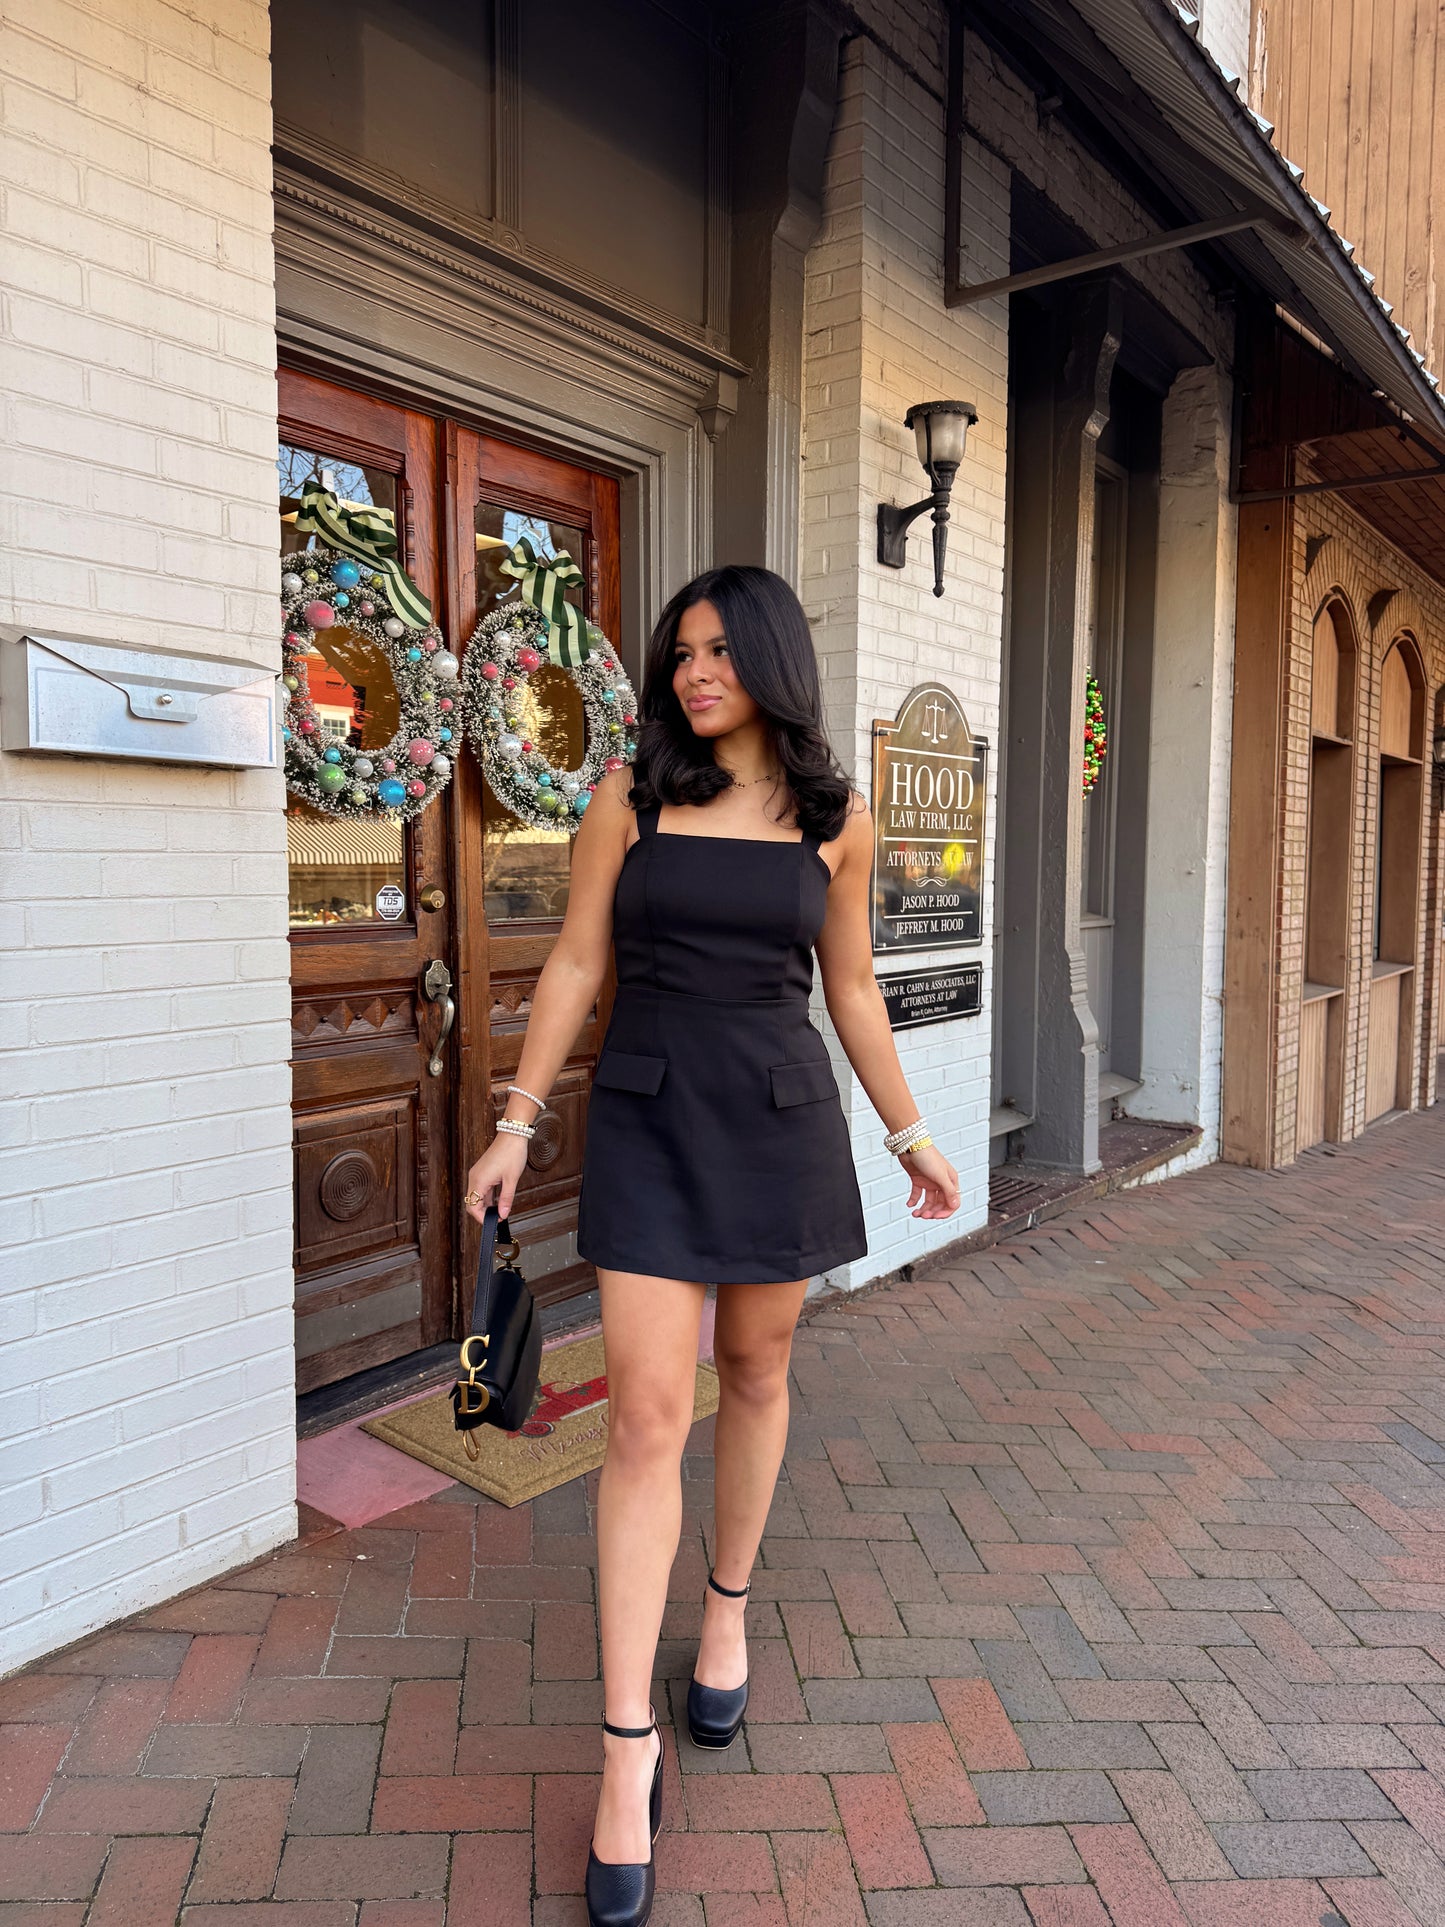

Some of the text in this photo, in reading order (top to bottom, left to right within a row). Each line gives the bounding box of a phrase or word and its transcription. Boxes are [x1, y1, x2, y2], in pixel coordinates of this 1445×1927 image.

[890, 762, 974, 809] HOOD
[890, 810, 973, 832] LAW FIRM, LLC
[886, 850, 942, 867] ATTORNEYS
[956, 851, 974, 867] AW
[383, 897, 399, 905] TDS
[900, 894, 960, 913] JASON P. HOOD
[894, 918, 964, 939] JEFFREY M. HOOD
[906, 982, 925, 994] CAHN
[925, 983, 930, 991] &
[930, 976, 965, 990] ASSOCIATES,
[965, 974, 977, 985] LLC
[900, 990, 958, 1008] ATTORNEYS AT LAW
